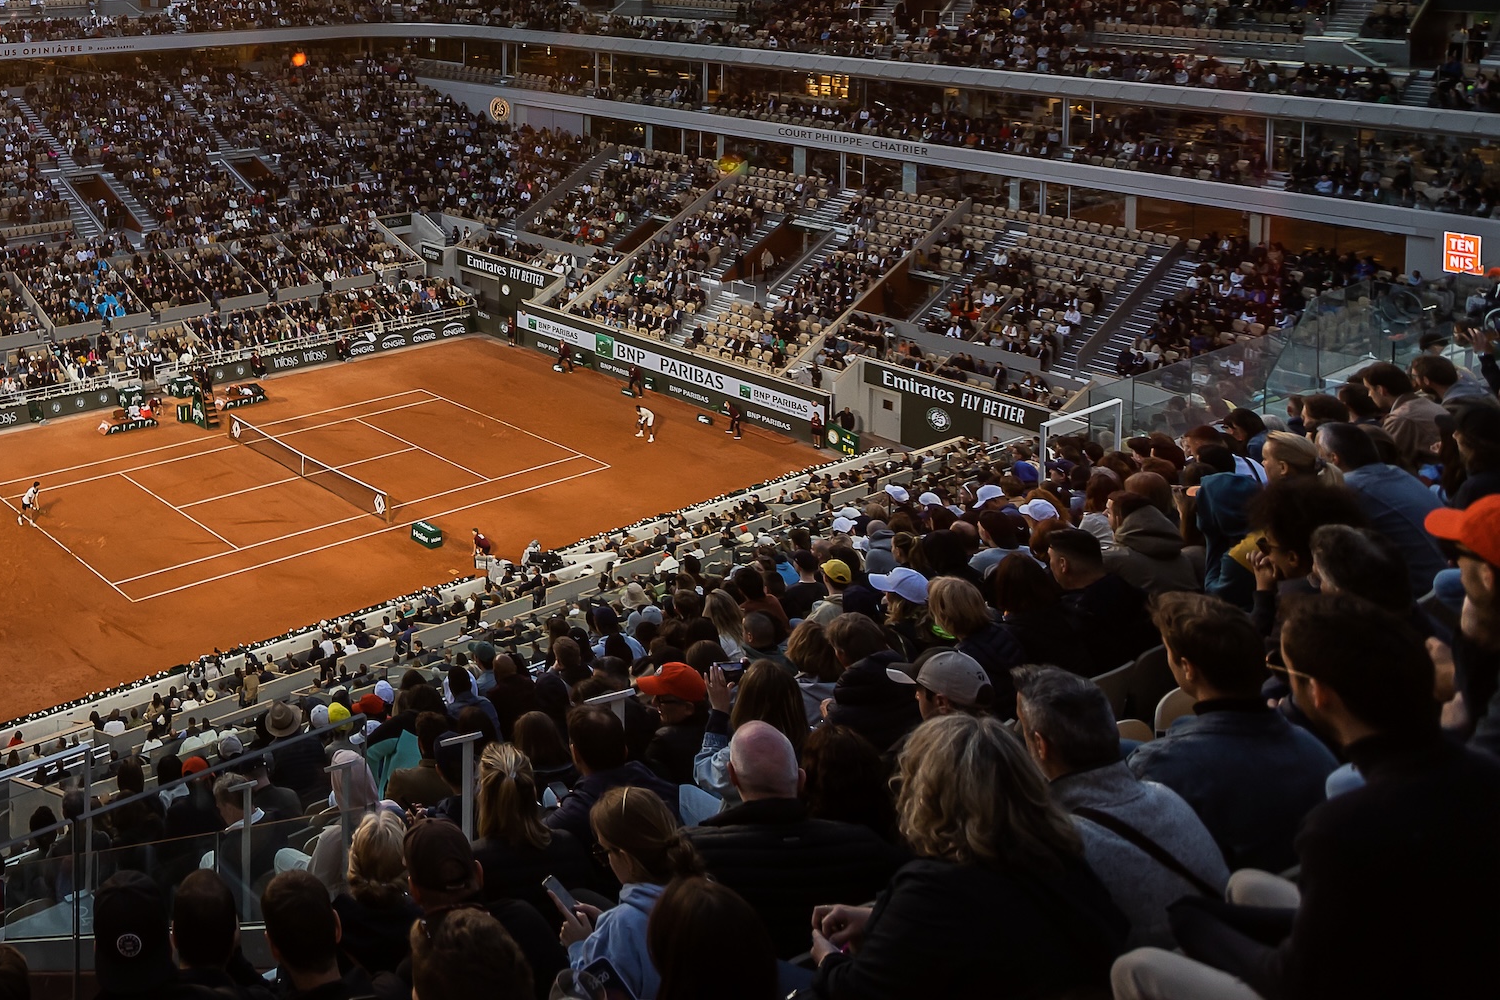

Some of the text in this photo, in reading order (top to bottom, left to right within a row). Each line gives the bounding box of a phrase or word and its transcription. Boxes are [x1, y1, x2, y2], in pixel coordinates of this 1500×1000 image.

[23, 45, 82, 55] OPINIÂTRE
[778, 127, 812, 140] COURT
[815, 132, 863, 147] PHILIPPE
[872, 140, 928, 156] CHATRIER
[1449, 238, 1475, 253] TEN
[466, 254, 545, 288] Emirates FLY BETTER
[1450, 255, 1474, 270] NIS
[538, 321, 550, 331] BNP
[552, 325, 579, 340] PARIBAS
[273, 355, 298, 369] Infosys
[303, 349, 328, 363] Infosys
[617, 344, 724, 391] BNP PARIBAS
[669, 384, 709, 404] BNP PARIBAS
[753, 389, 808, 413] BNP PARIBAS
[882, 370, 955, 405] Emirates
[960, 392, 980, 412] FLY
[982, 398, 1026, 425] BETTER
[746, 410, 792, 431] BNP PARIBAS
